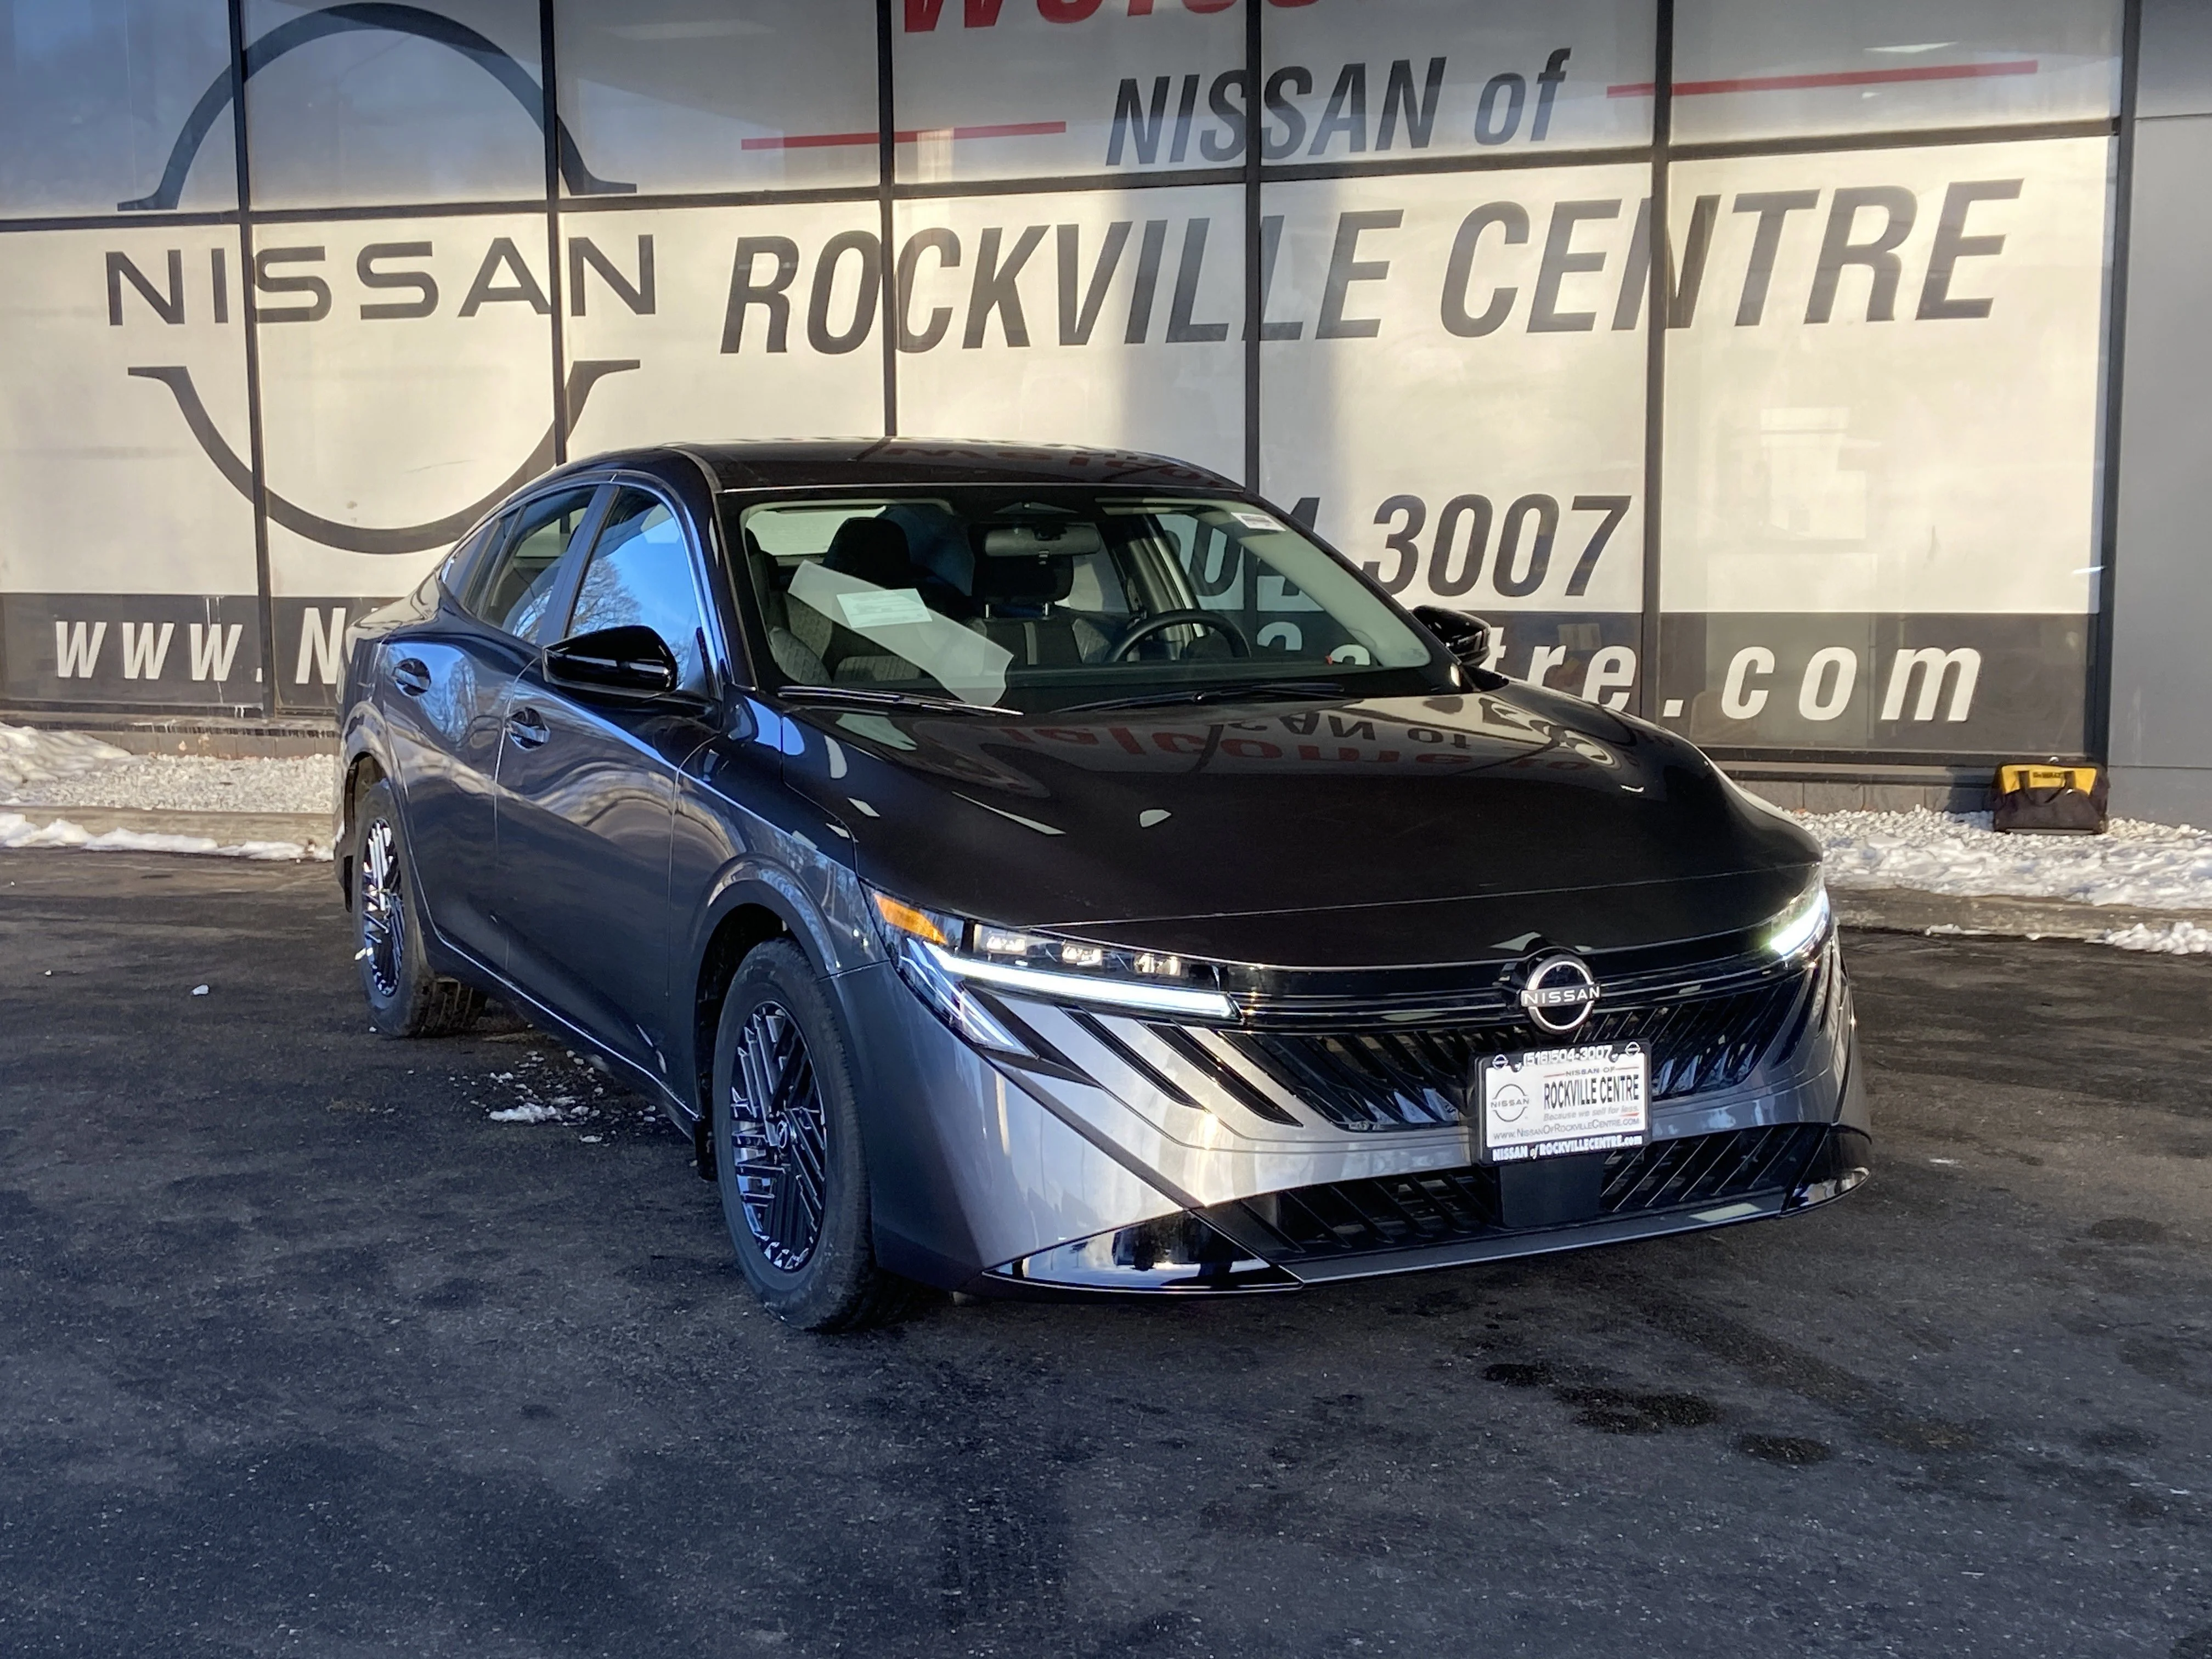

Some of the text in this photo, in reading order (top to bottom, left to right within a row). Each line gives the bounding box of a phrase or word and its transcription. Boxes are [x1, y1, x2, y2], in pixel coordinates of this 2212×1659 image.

[1105, 47, 1572, 166] NISSAN of
[719, 178, 2025, 355] ROCKVILLE CENTRE
[105, 234, 657, 326] NISSAN
[1523, 985, 1600, 1005] NISSAN
[1565, 1068, 1600, 1076] NISSAN
[1543, 1074, 1640, 1110] ROCKVILLE CENTRE
[1490, 1098, 1530, 1108] NISSAN
[1543, 1111, 1577, 1121] Because
[1592, 1107, 1606, 1116] sell
[1608, 1105, 1620, 1115] for
[1492, 1144, 1528, 1162] NISSAN
